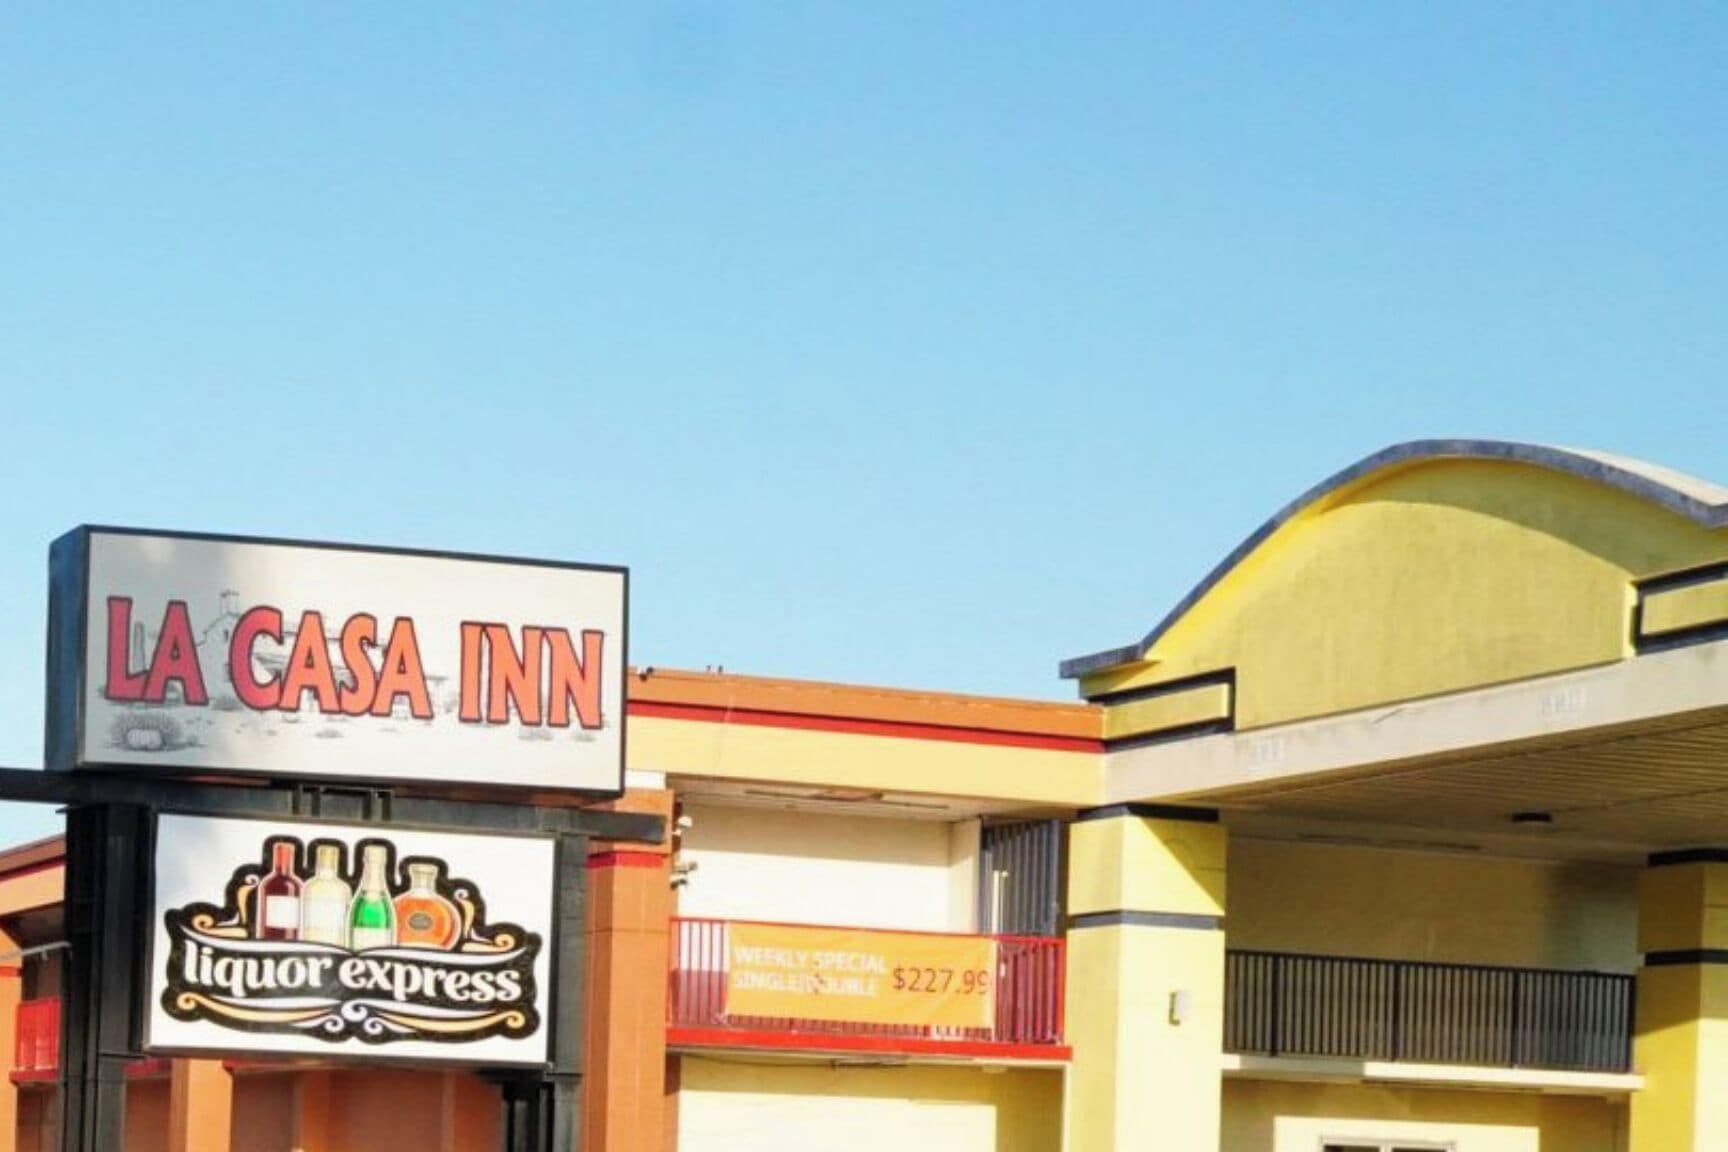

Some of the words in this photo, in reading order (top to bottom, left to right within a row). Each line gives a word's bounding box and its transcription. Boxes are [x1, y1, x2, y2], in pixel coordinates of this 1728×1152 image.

[106, 596, 209, 707] LA
[228, 606, 434, 720] CASA
[459, 621, 604, 729] INN
[184, 939, 332, 998] liquor
[338, 957, 522, 1002] express
[734, 945, 808, 970] WEEKLY
[811, 950, 888, 975] SPECIAL
[892, 963, 989, 995] $227.99
